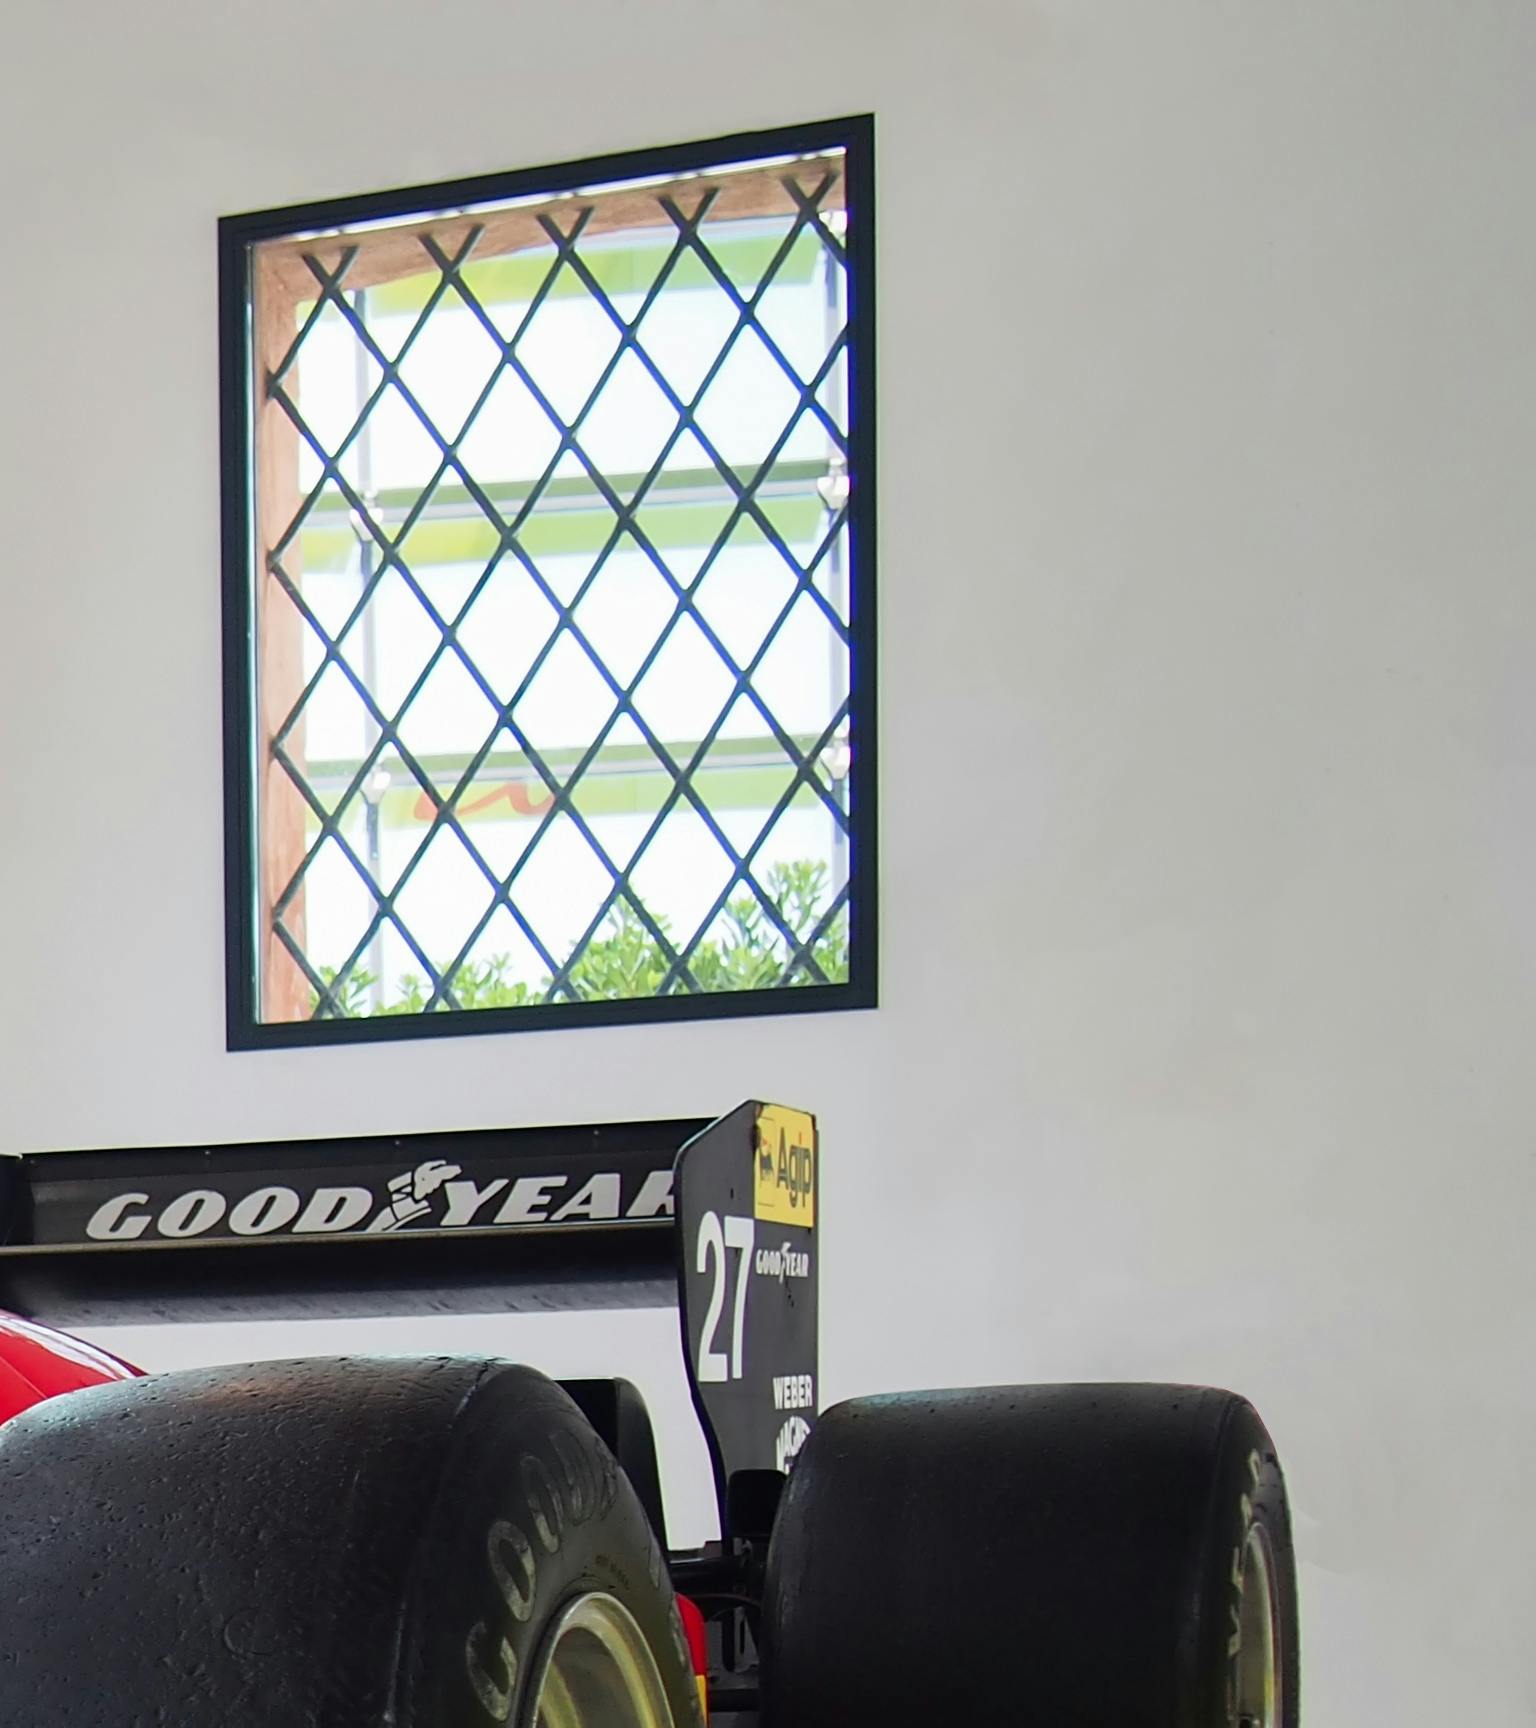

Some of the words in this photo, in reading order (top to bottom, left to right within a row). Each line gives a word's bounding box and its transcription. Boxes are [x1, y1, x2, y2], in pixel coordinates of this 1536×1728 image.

[776, 1126, 813, 1210] Agip
[696, 1210, 755, 1383] 27
[773, 1374, 813, 1410] WEBER
